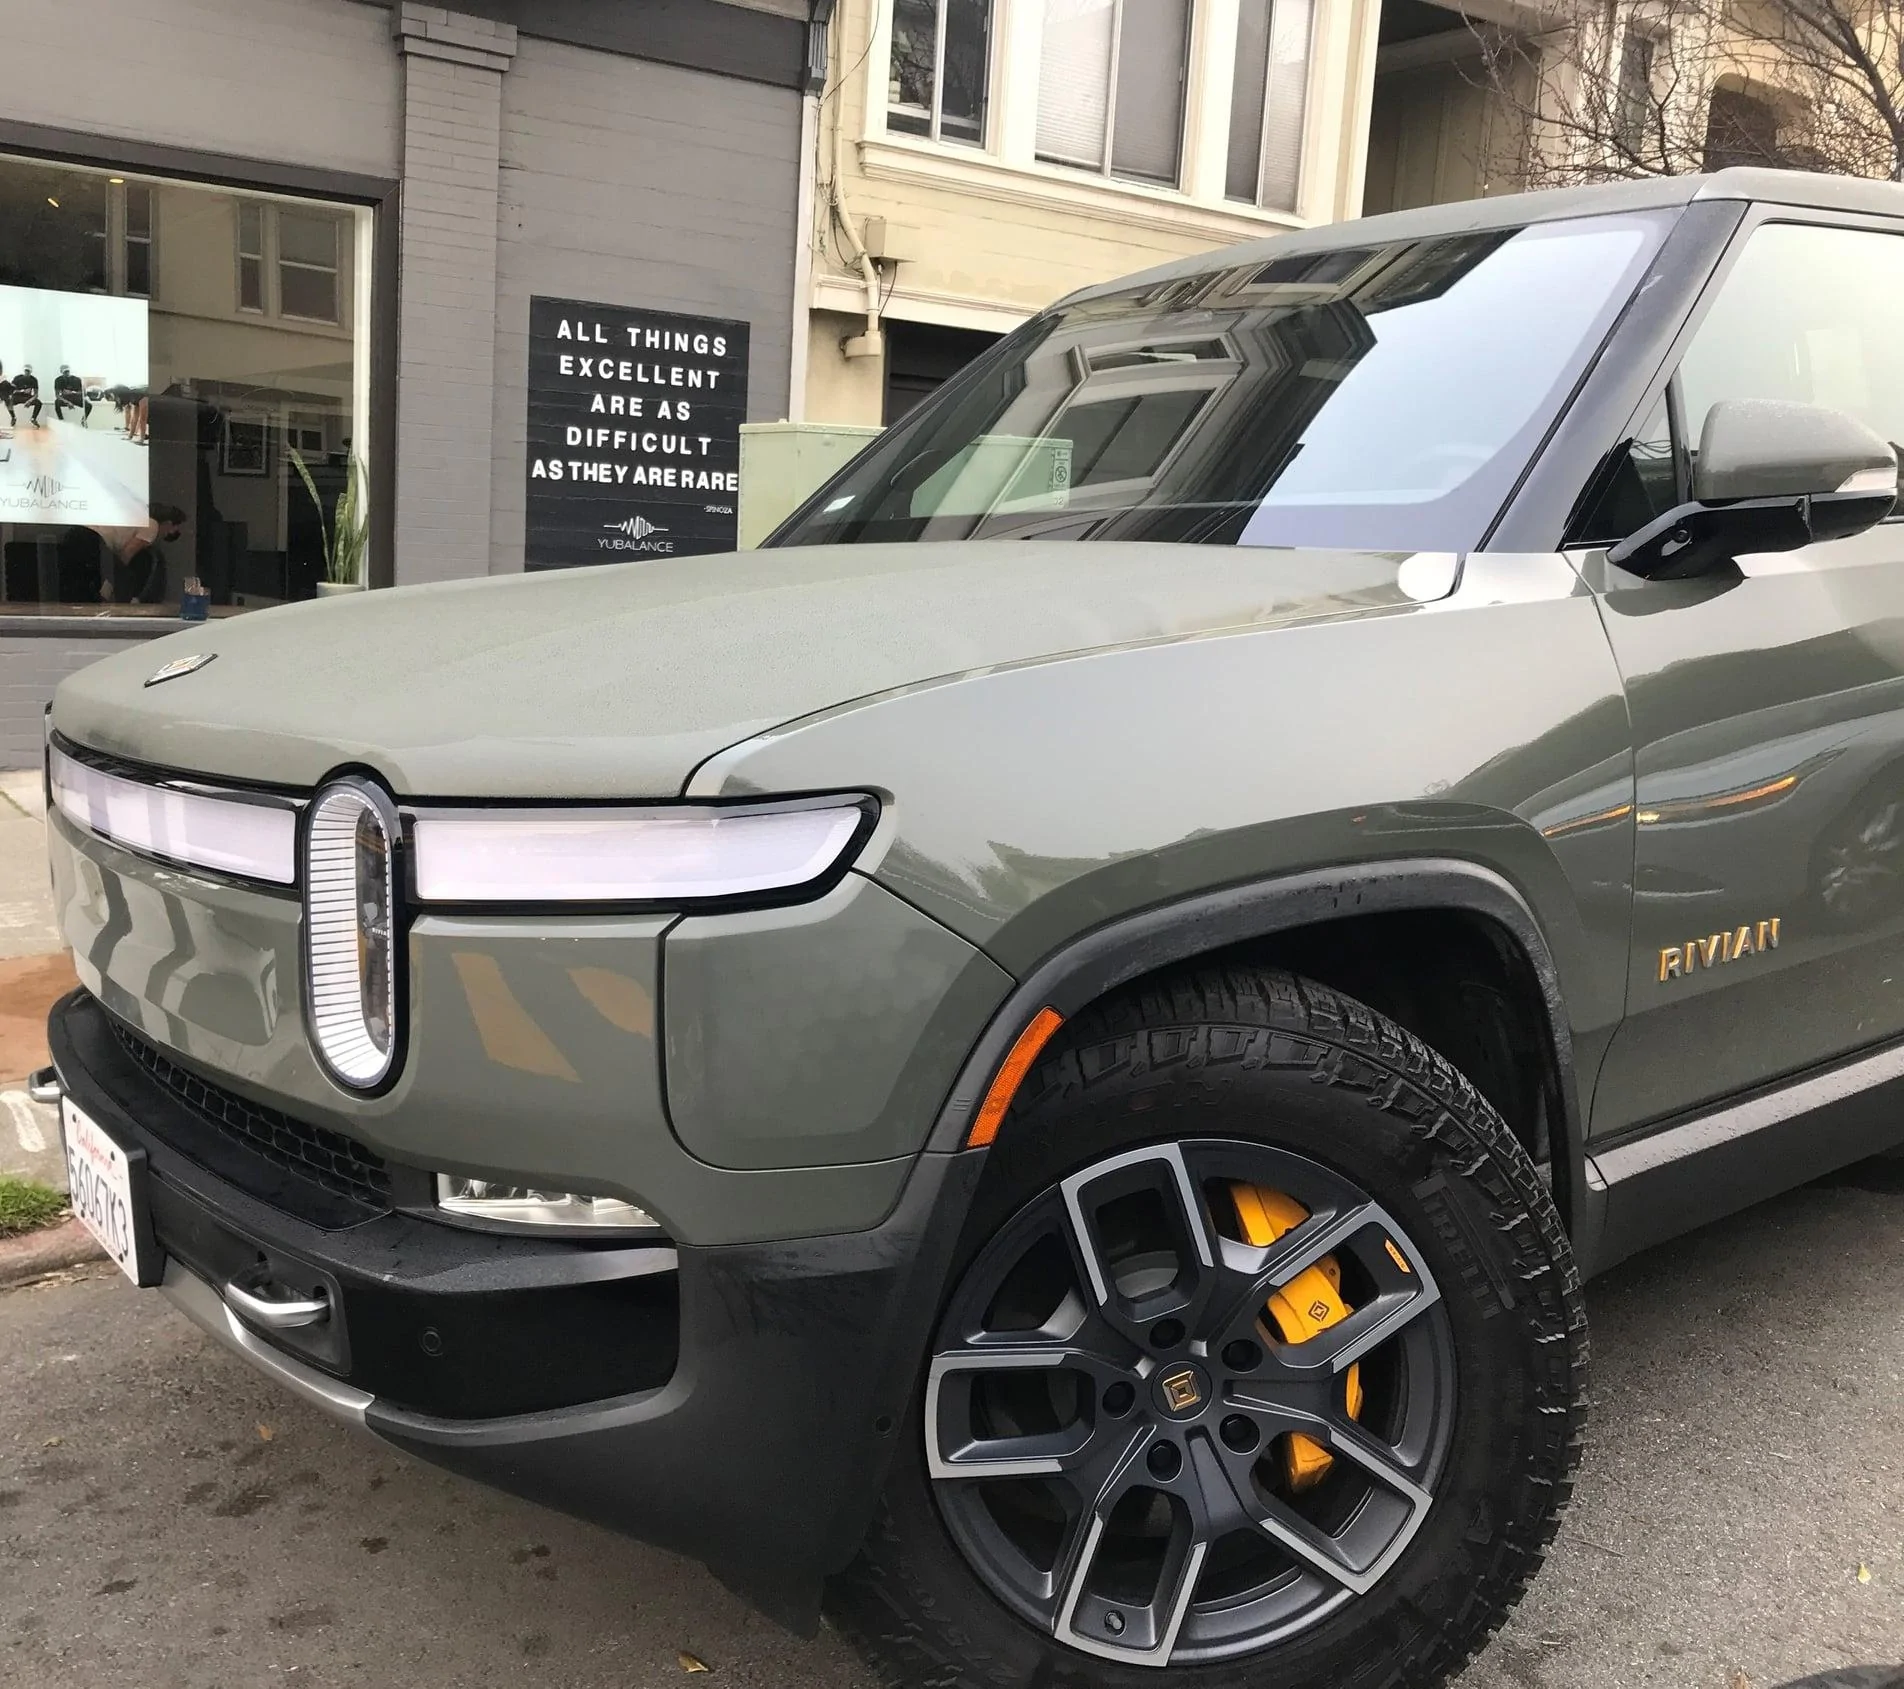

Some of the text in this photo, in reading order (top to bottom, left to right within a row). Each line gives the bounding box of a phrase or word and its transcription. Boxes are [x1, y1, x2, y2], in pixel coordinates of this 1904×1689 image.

[557, 319, 727, 357] ALL THINGS
[560, 355, 720, 389] EXCELLENT
[591, 394, 691, 421] ARE AS
[566, 426, 712, 455] DIFFICULT
[532, 459, 738, 492] AS THEY ARE RARE
[0, 497, 88, 511] YUBALANCE
[597, 538, 674, 553] YUBALANCE
[1659, 918, 1780, 981] RIVIAN
